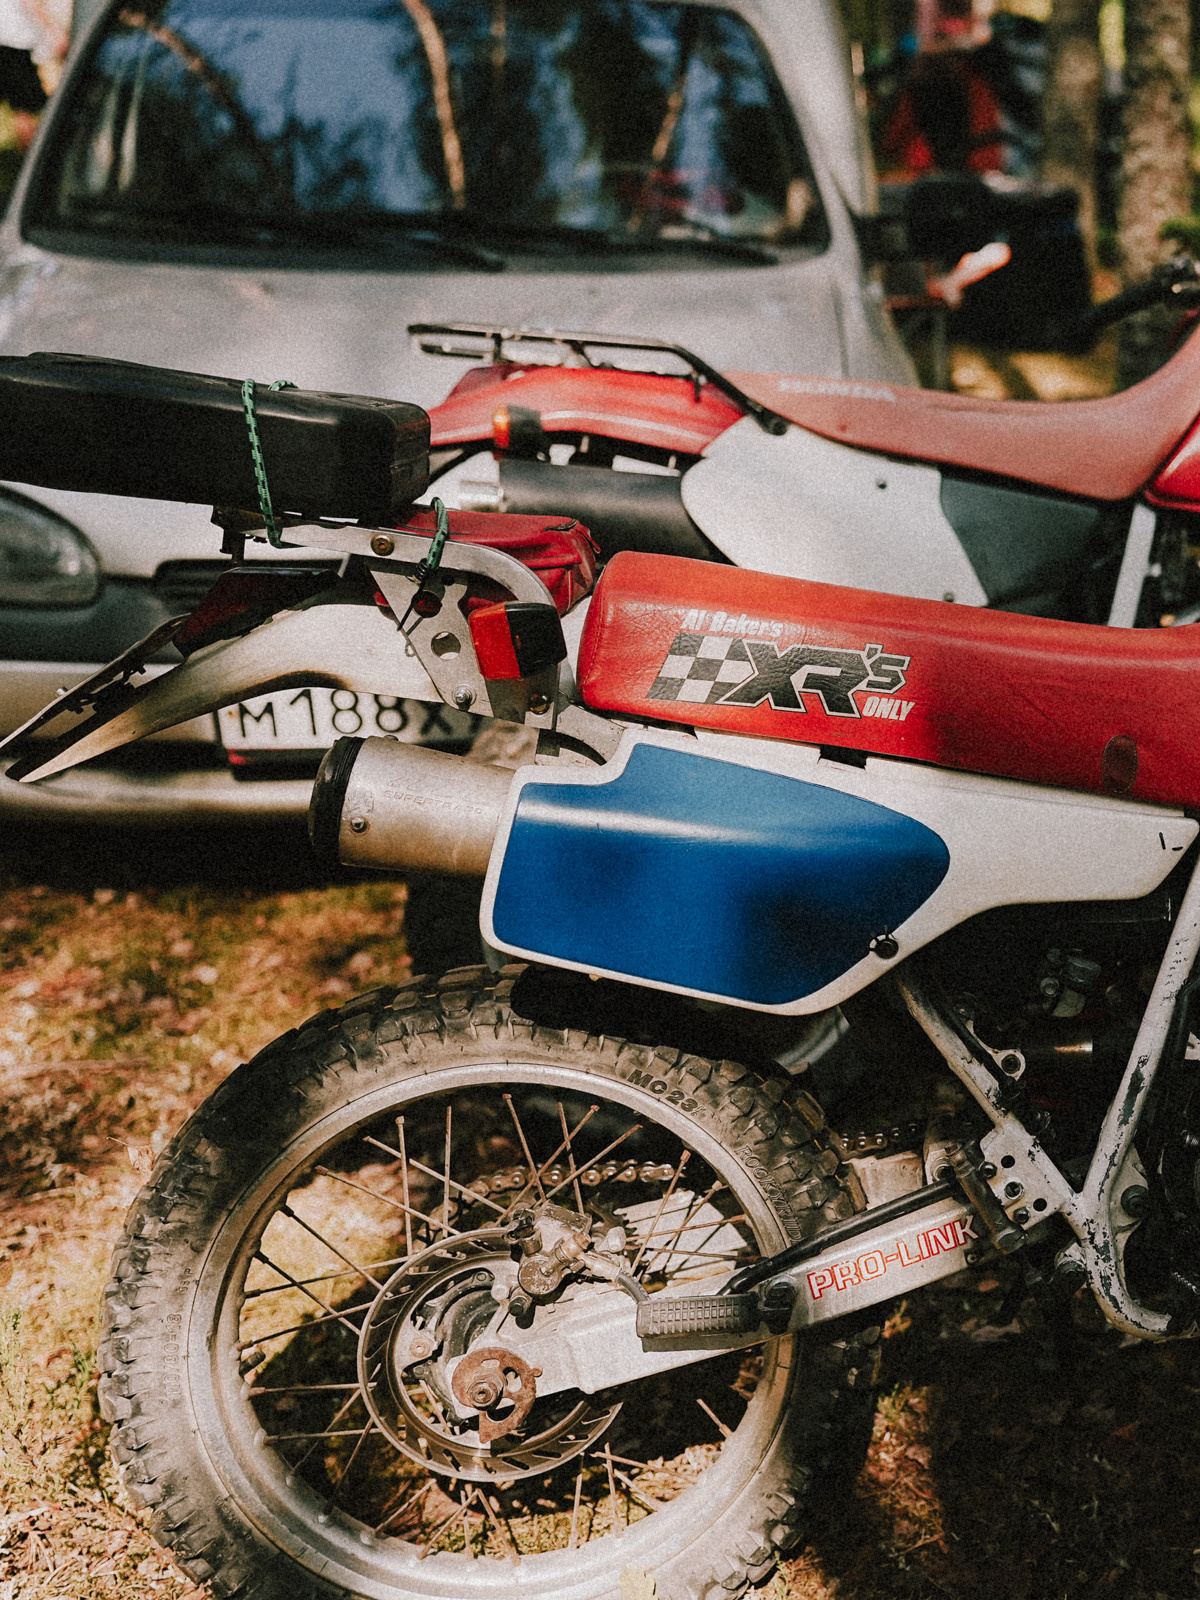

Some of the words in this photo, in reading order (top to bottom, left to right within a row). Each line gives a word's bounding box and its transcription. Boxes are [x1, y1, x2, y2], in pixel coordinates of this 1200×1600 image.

[709, 611, 784, 638] Baker's
[861, 696, 915, 721] ONLY
[383, 789, 482, 815] SUPERTRAPP
[626, 1069, 668, 1095] MC
[807, 1215, 980, 1300] PRO-LINK
